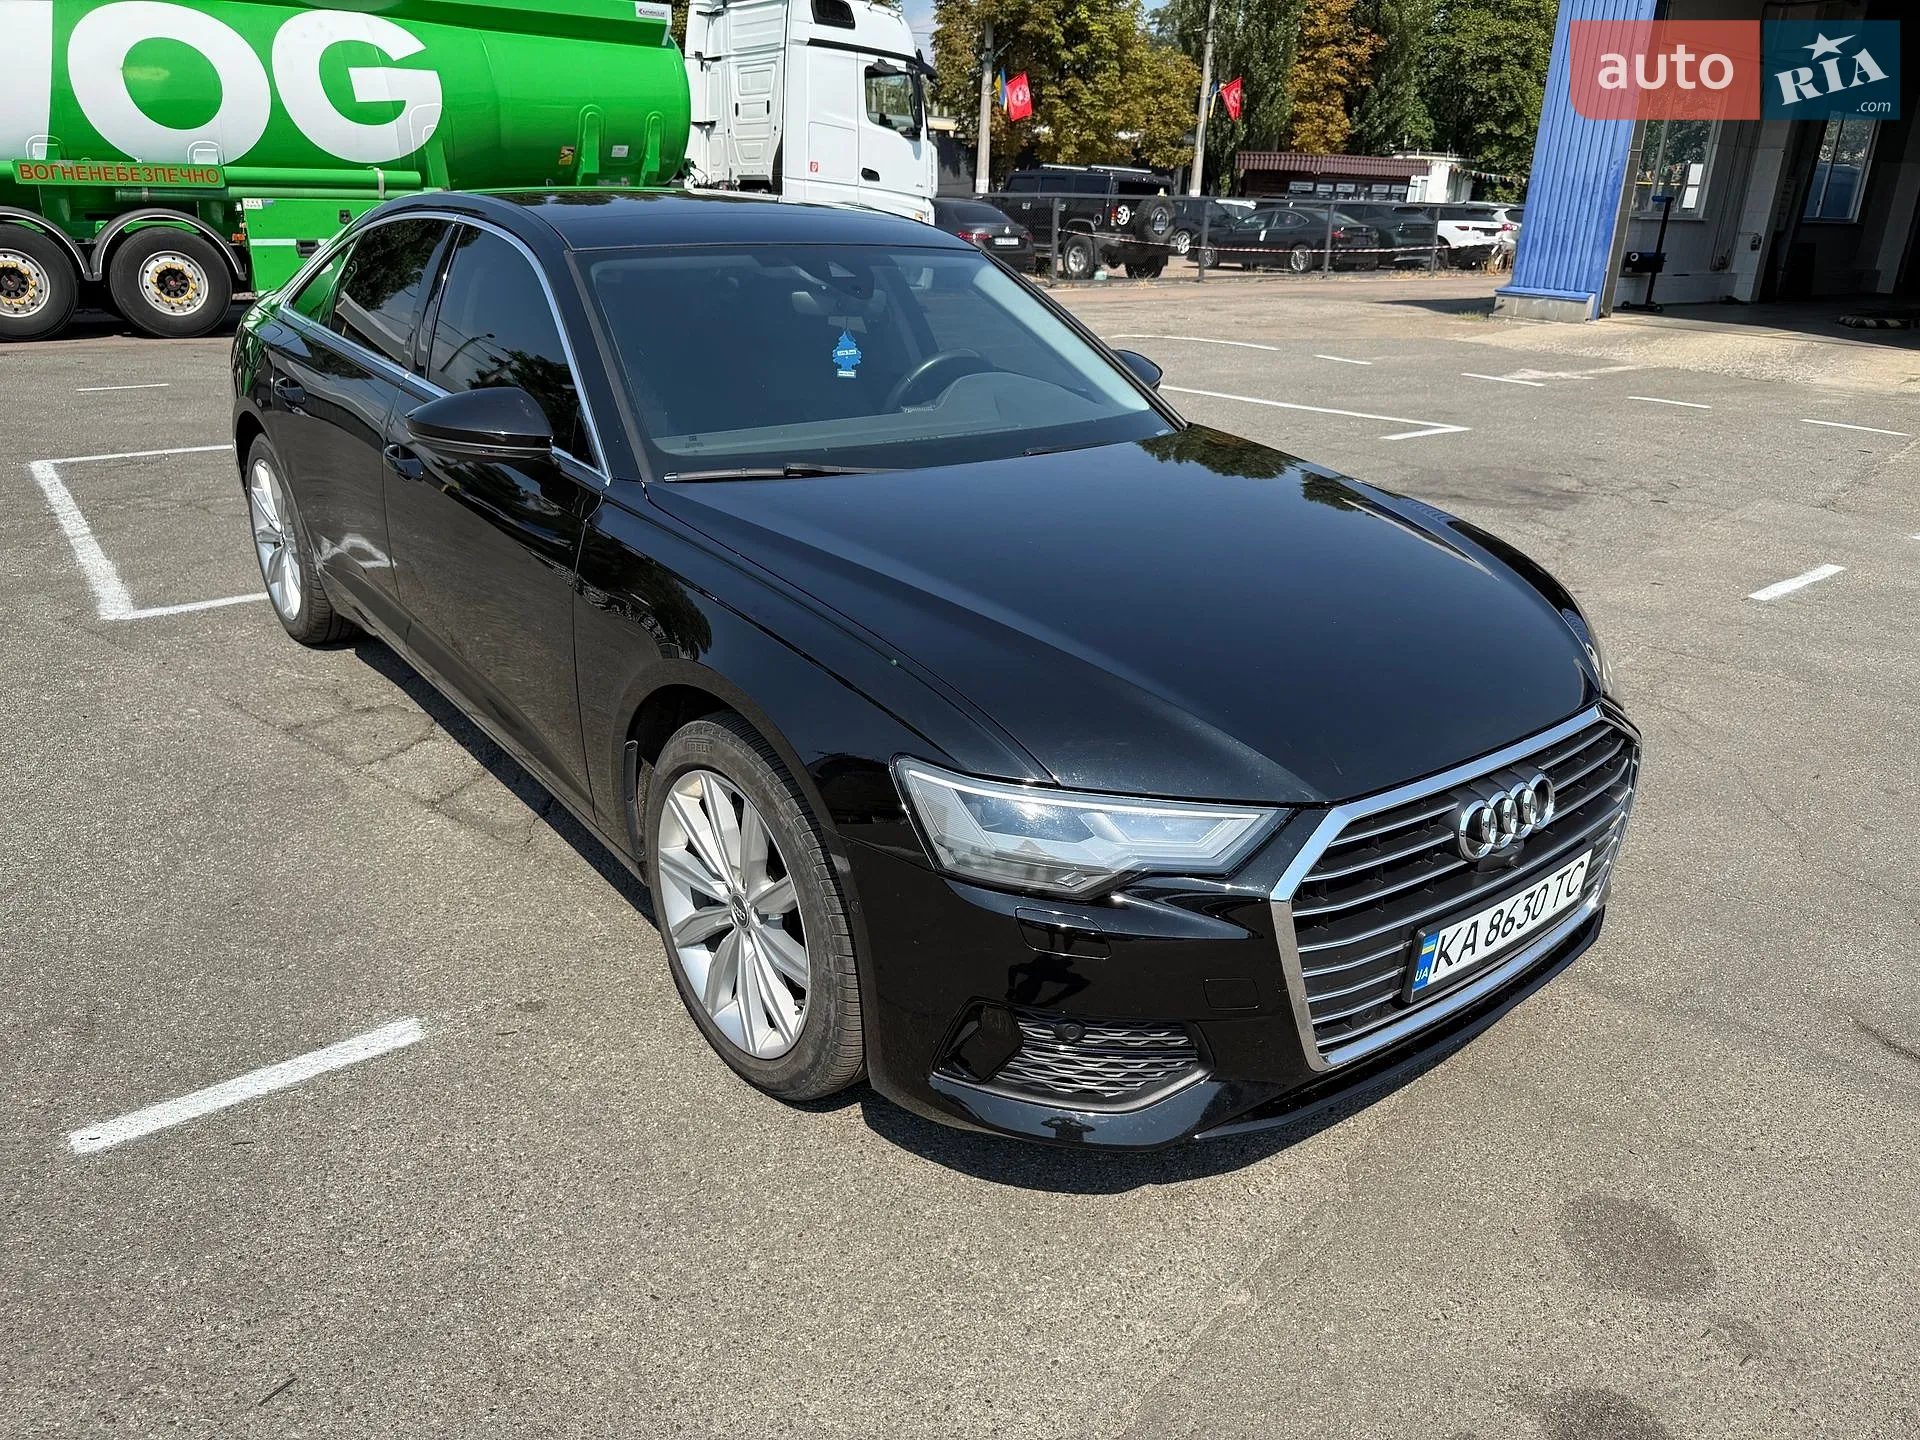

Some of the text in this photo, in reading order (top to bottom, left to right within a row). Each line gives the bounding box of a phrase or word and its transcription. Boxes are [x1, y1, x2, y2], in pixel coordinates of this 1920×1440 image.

[19, 163, 220, 184] ВОГНЕНЕБЕЗПЕЧНО
[1433, 861, 1585, 974] KA 8630 TC
[1415, 966, 1429, 982] UA
